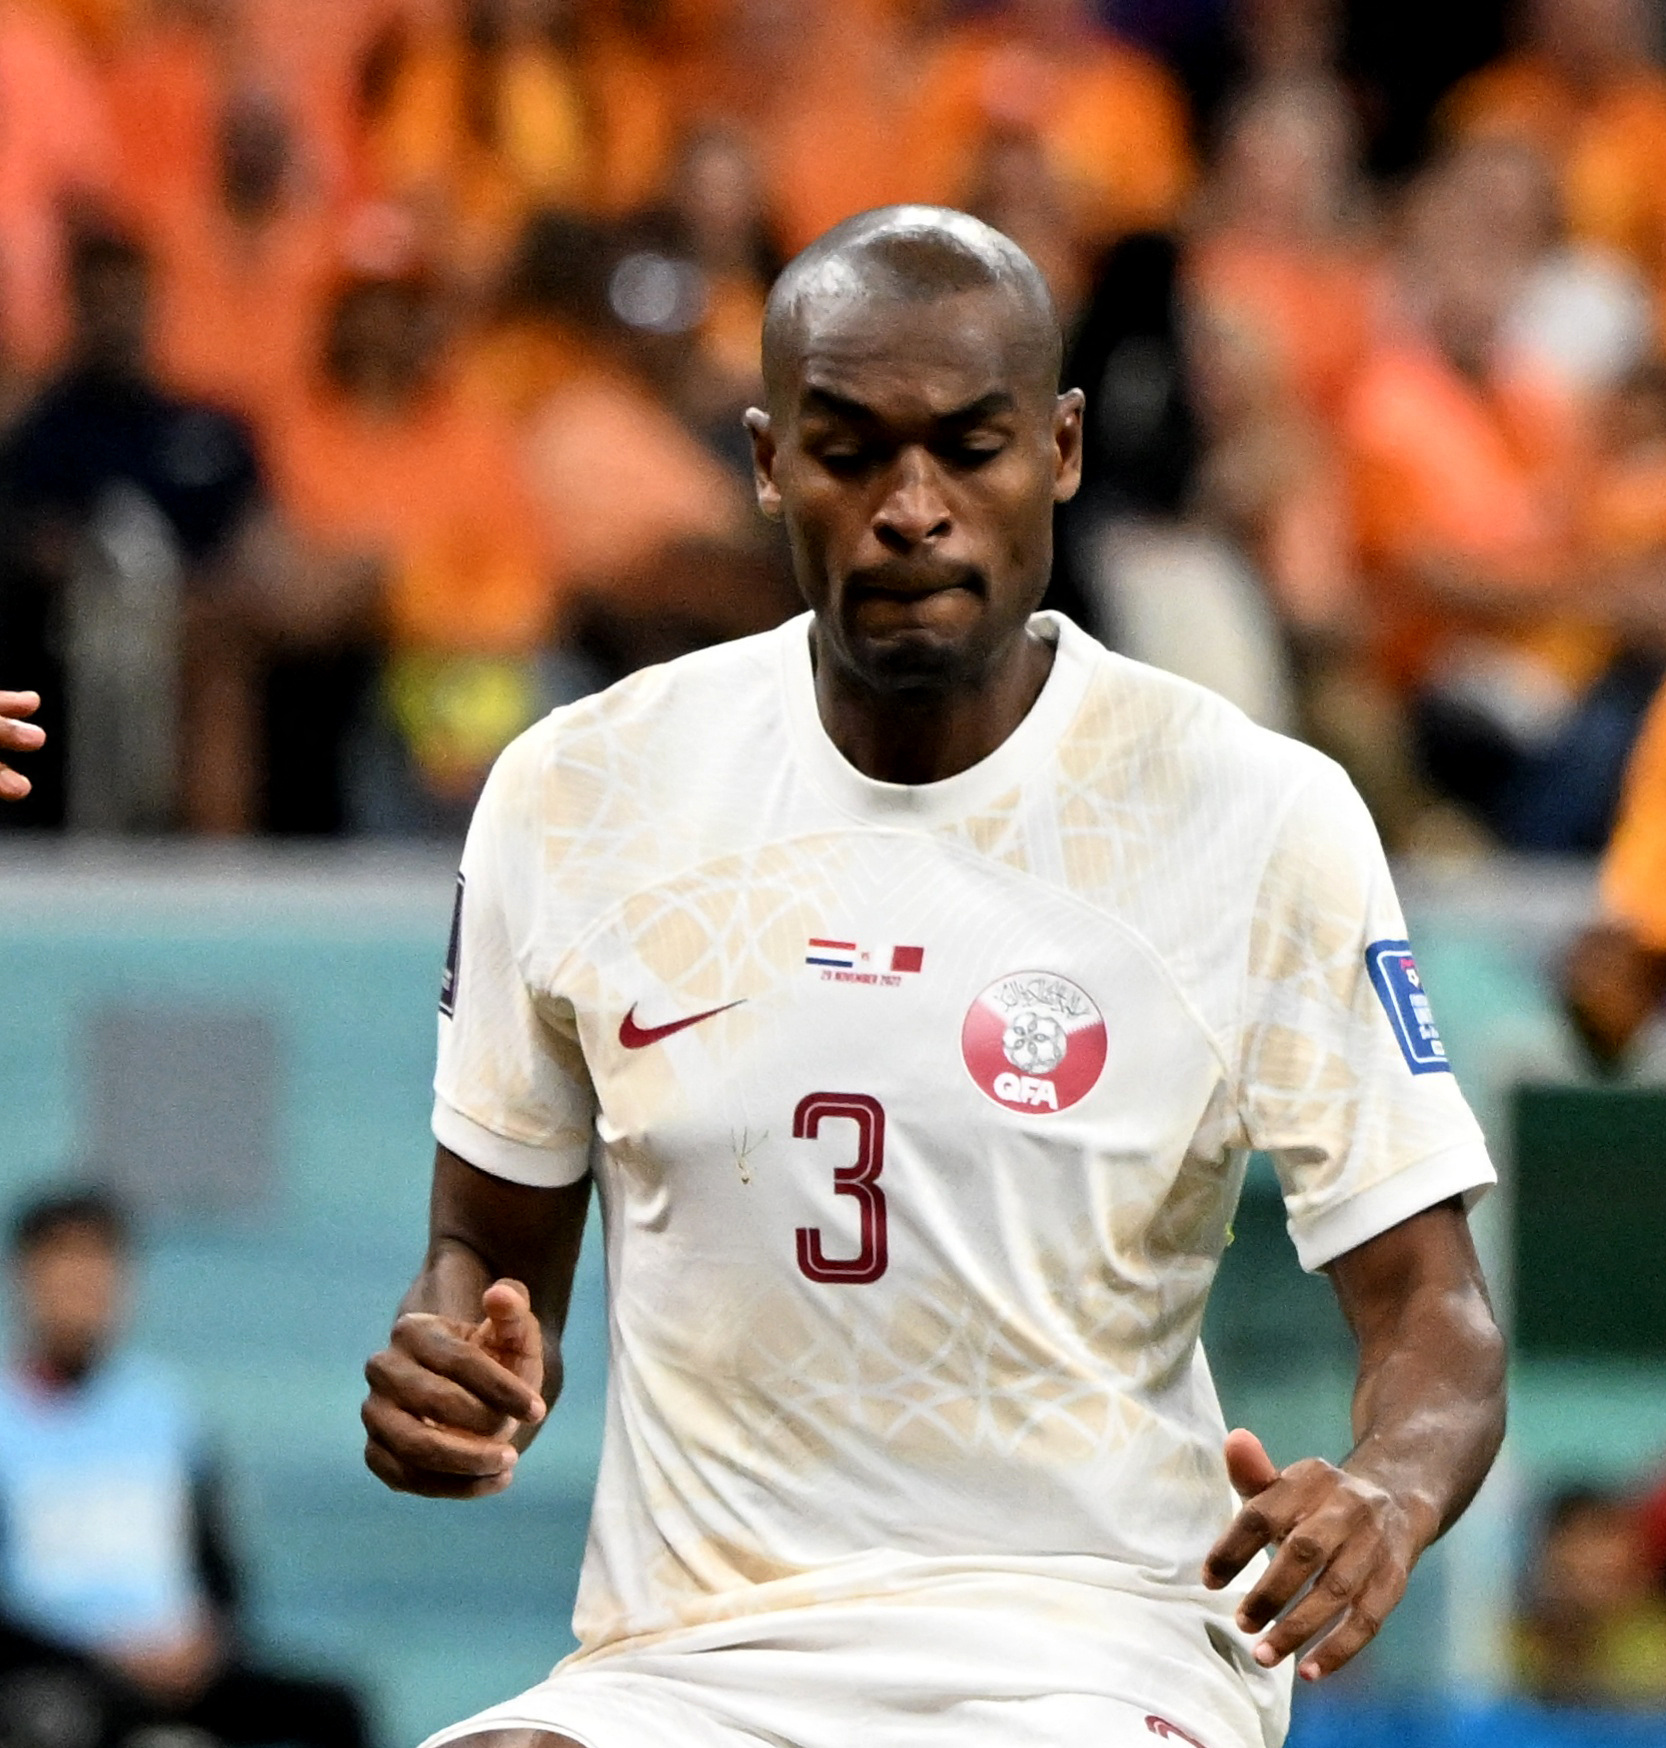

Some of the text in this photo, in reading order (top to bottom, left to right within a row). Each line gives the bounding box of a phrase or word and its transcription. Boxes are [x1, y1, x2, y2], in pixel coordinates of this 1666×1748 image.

[835, 971, 878, 985] NOVEMBER
[993, 1071, 1059, 1111] QFA
[792, 1091, 888, 1284] 3
